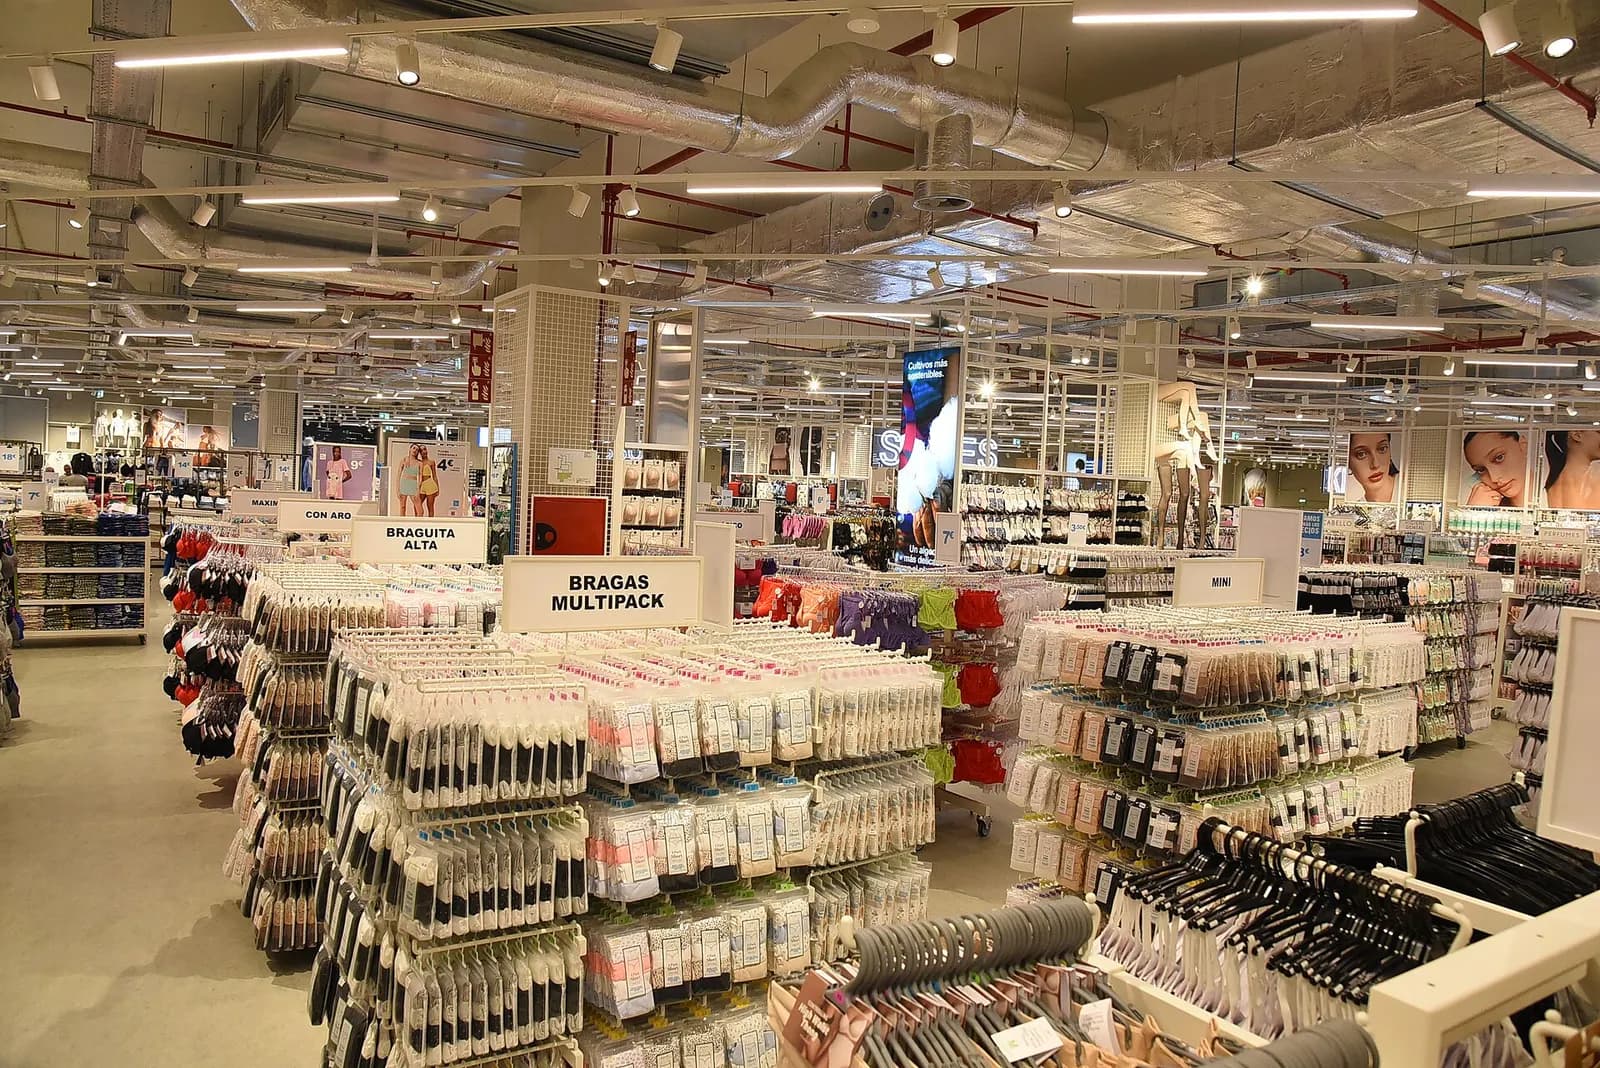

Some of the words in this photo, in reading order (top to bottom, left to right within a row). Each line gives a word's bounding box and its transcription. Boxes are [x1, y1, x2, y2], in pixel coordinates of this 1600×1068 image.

[908, 361, 933, 370] Cultivos
[934, 359, 948, 368] más
[351, 461, 364, 470] 9€
[437, 459, 455, 471] 4€
[306, 511, 328, 519] CON
[387, 528, 455, 538] BRAGUITA
[1543, 530, 1580, 538] PERFUMES
[404, 541, 438, 550] ALTA
[569, 574, 649, 590] BRAGAS
[1212, 577, 1231, 588] MINI
[552, 594, 664, 611] MULTIPACK
